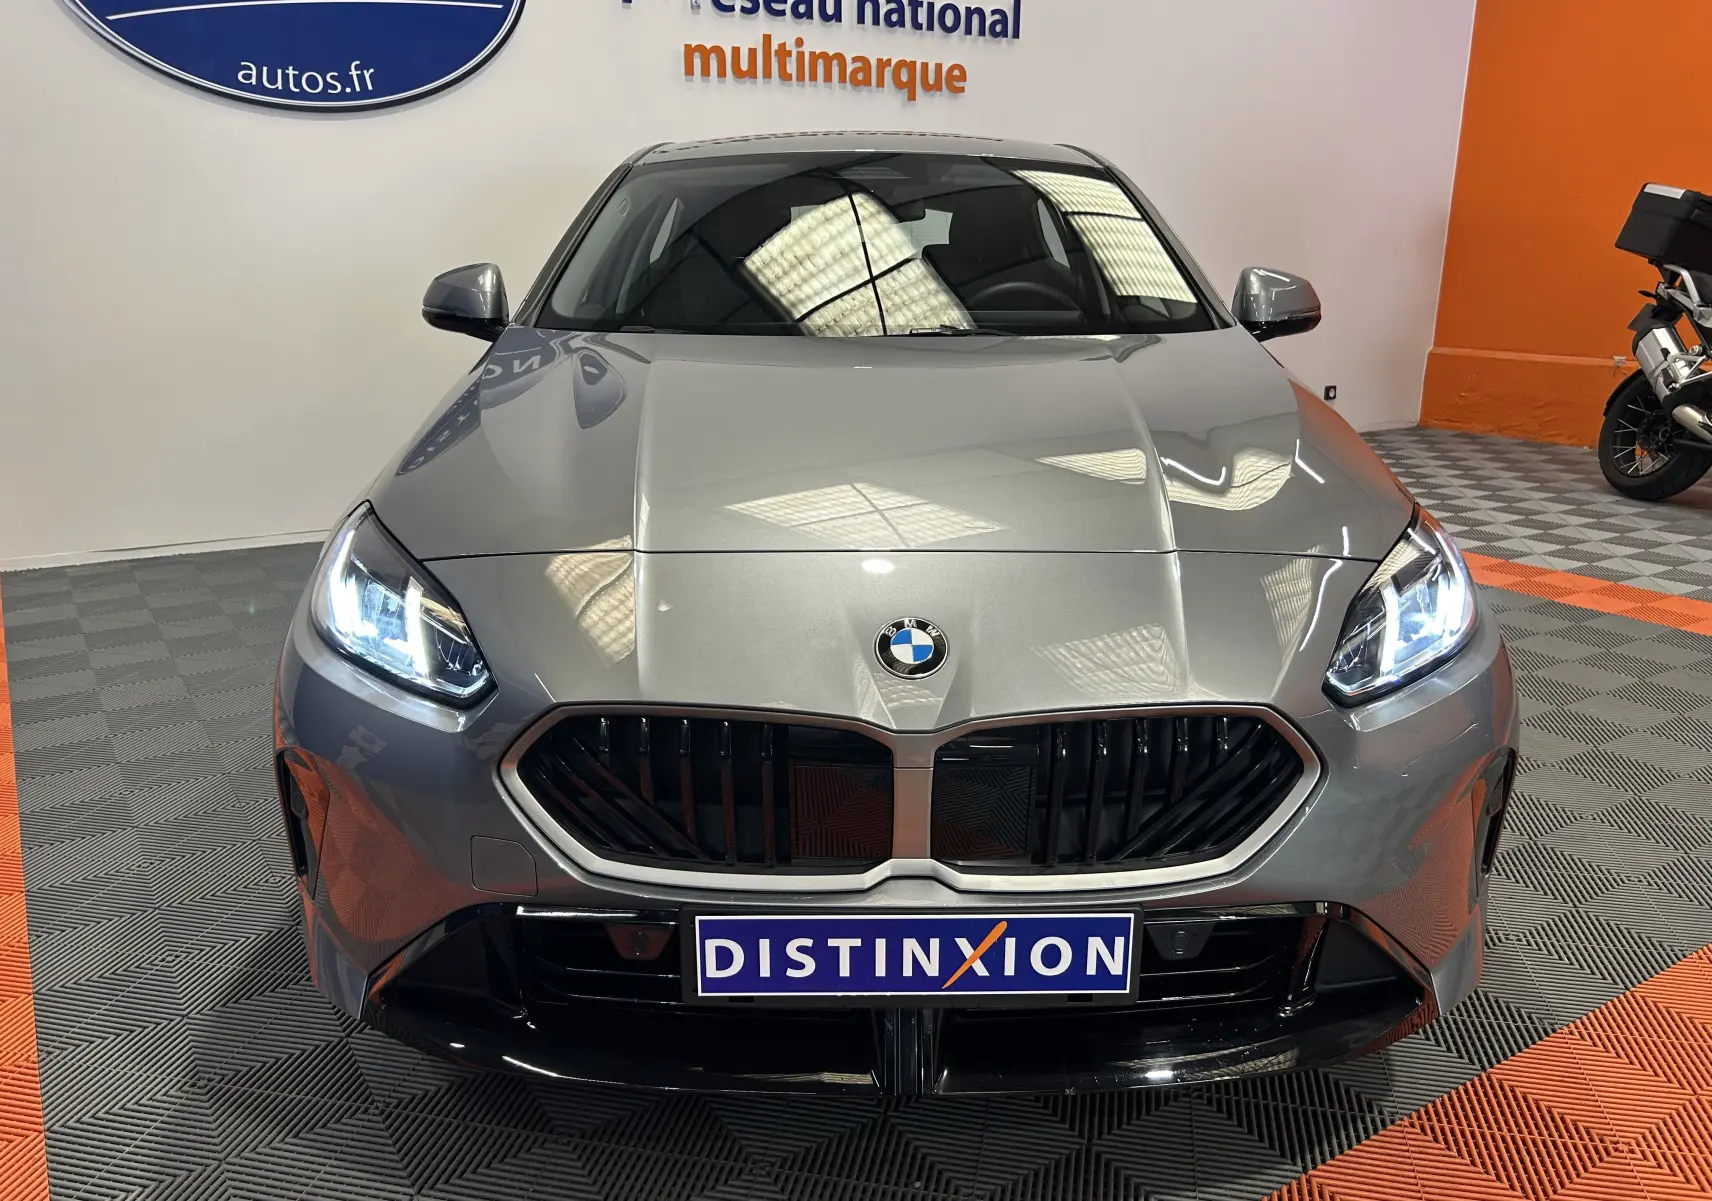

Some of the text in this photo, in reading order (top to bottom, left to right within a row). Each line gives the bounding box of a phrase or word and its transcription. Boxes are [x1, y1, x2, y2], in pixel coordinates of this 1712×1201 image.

[691, 0, 1022, 39] eau national
[237, 60, 375, 94] autos.fr
[684, 34, 967, 101] multimarque
[885, 619, 940, 637] BMW
[704, 920, 1125, 989] DISTINXION
